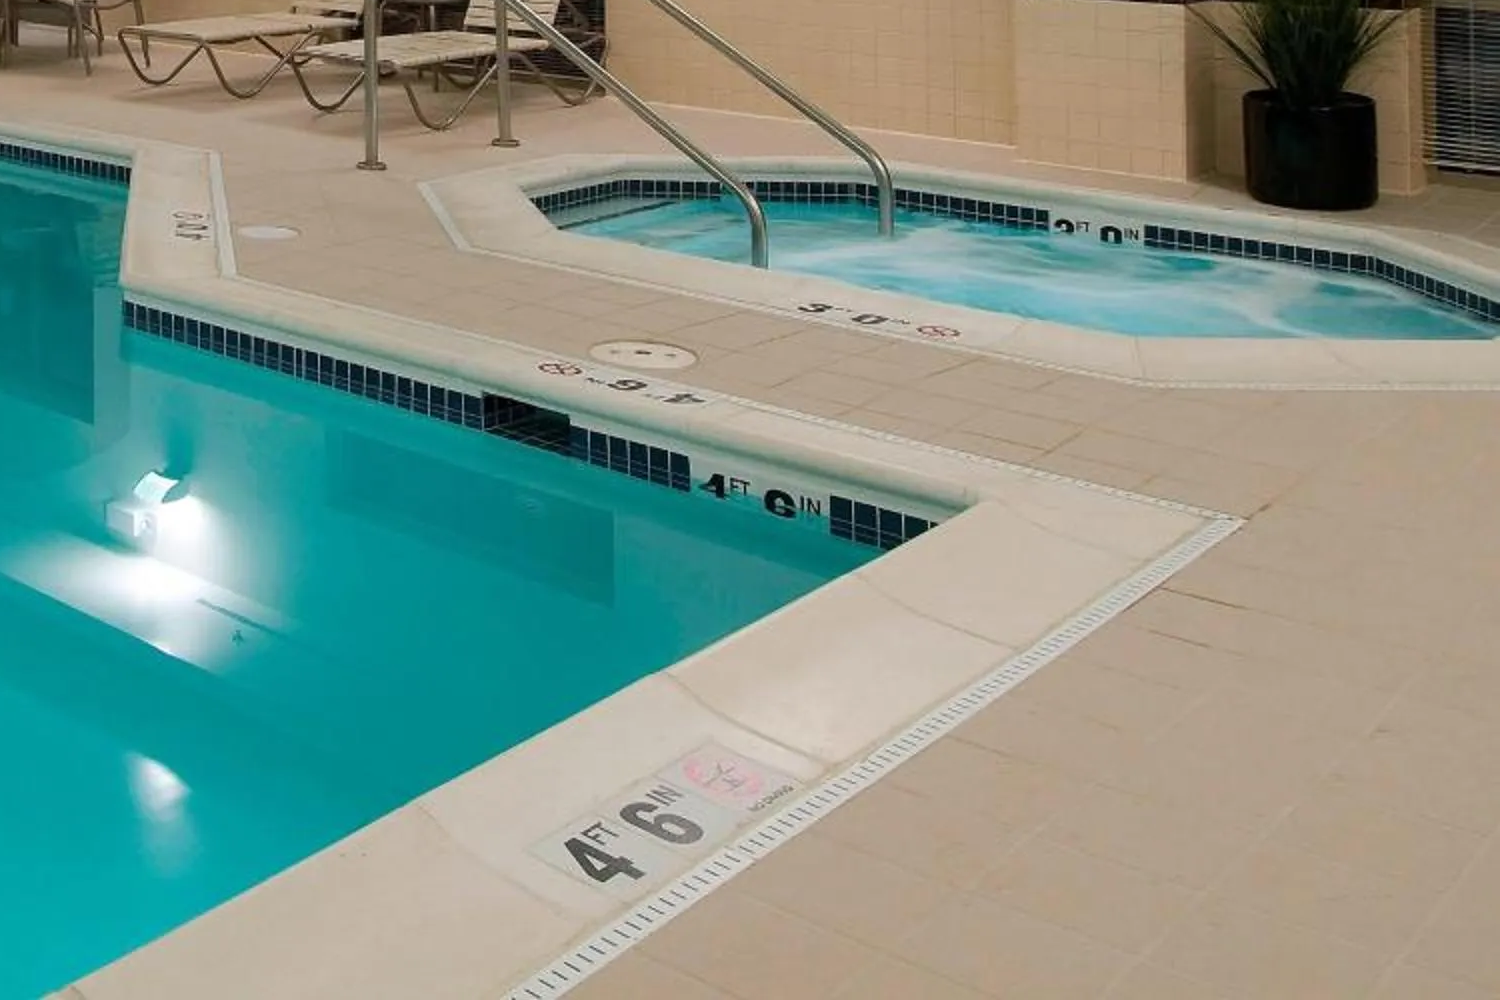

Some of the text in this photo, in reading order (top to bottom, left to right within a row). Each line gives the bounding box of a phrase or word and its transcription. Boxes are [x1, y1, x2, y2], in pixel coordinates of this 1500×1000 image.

[729, 477, 750, 496] FT
[800, 496, 822, 516] IN
[564, 784, 705, 883] 4 FT 6 IN
